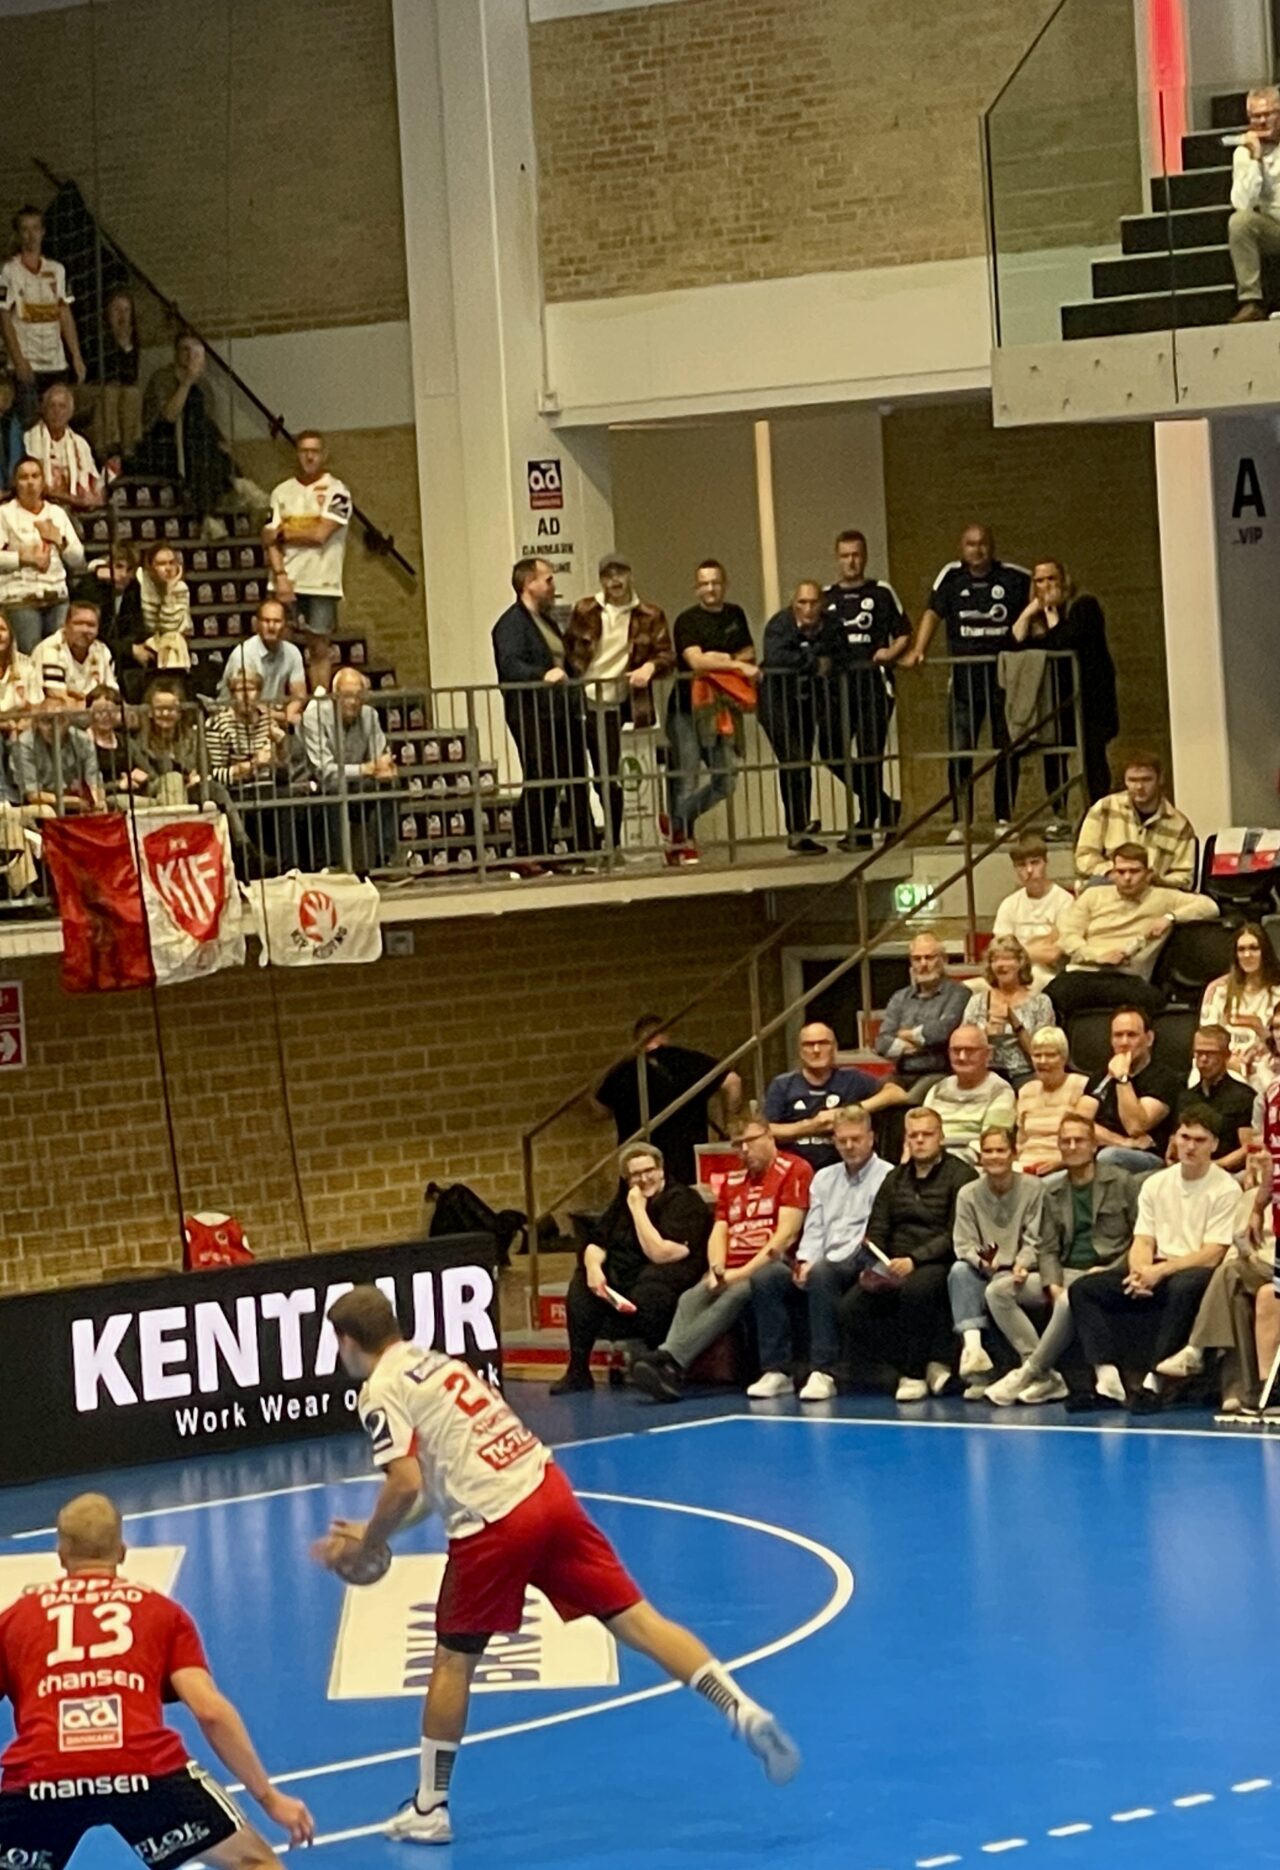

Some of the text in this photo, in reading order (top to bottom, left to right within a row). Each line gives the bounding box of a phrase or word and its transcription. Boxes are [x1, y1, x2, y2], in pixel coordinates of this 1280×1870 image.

[1231, 458, 1267, 518] A
[537, 516, 561, 536] AD
[1238, 526, 1263, 545] VIP
[156, 852, 217, 926] KIF
[175, 1402, 247, 1437] Work
[260, 1394, 329, 1424] Wear
[46, 1602, 133, 1667] 13
[38, 1669, 145, 1698] thansen
[29, 1774, 149, 1800] thansen
